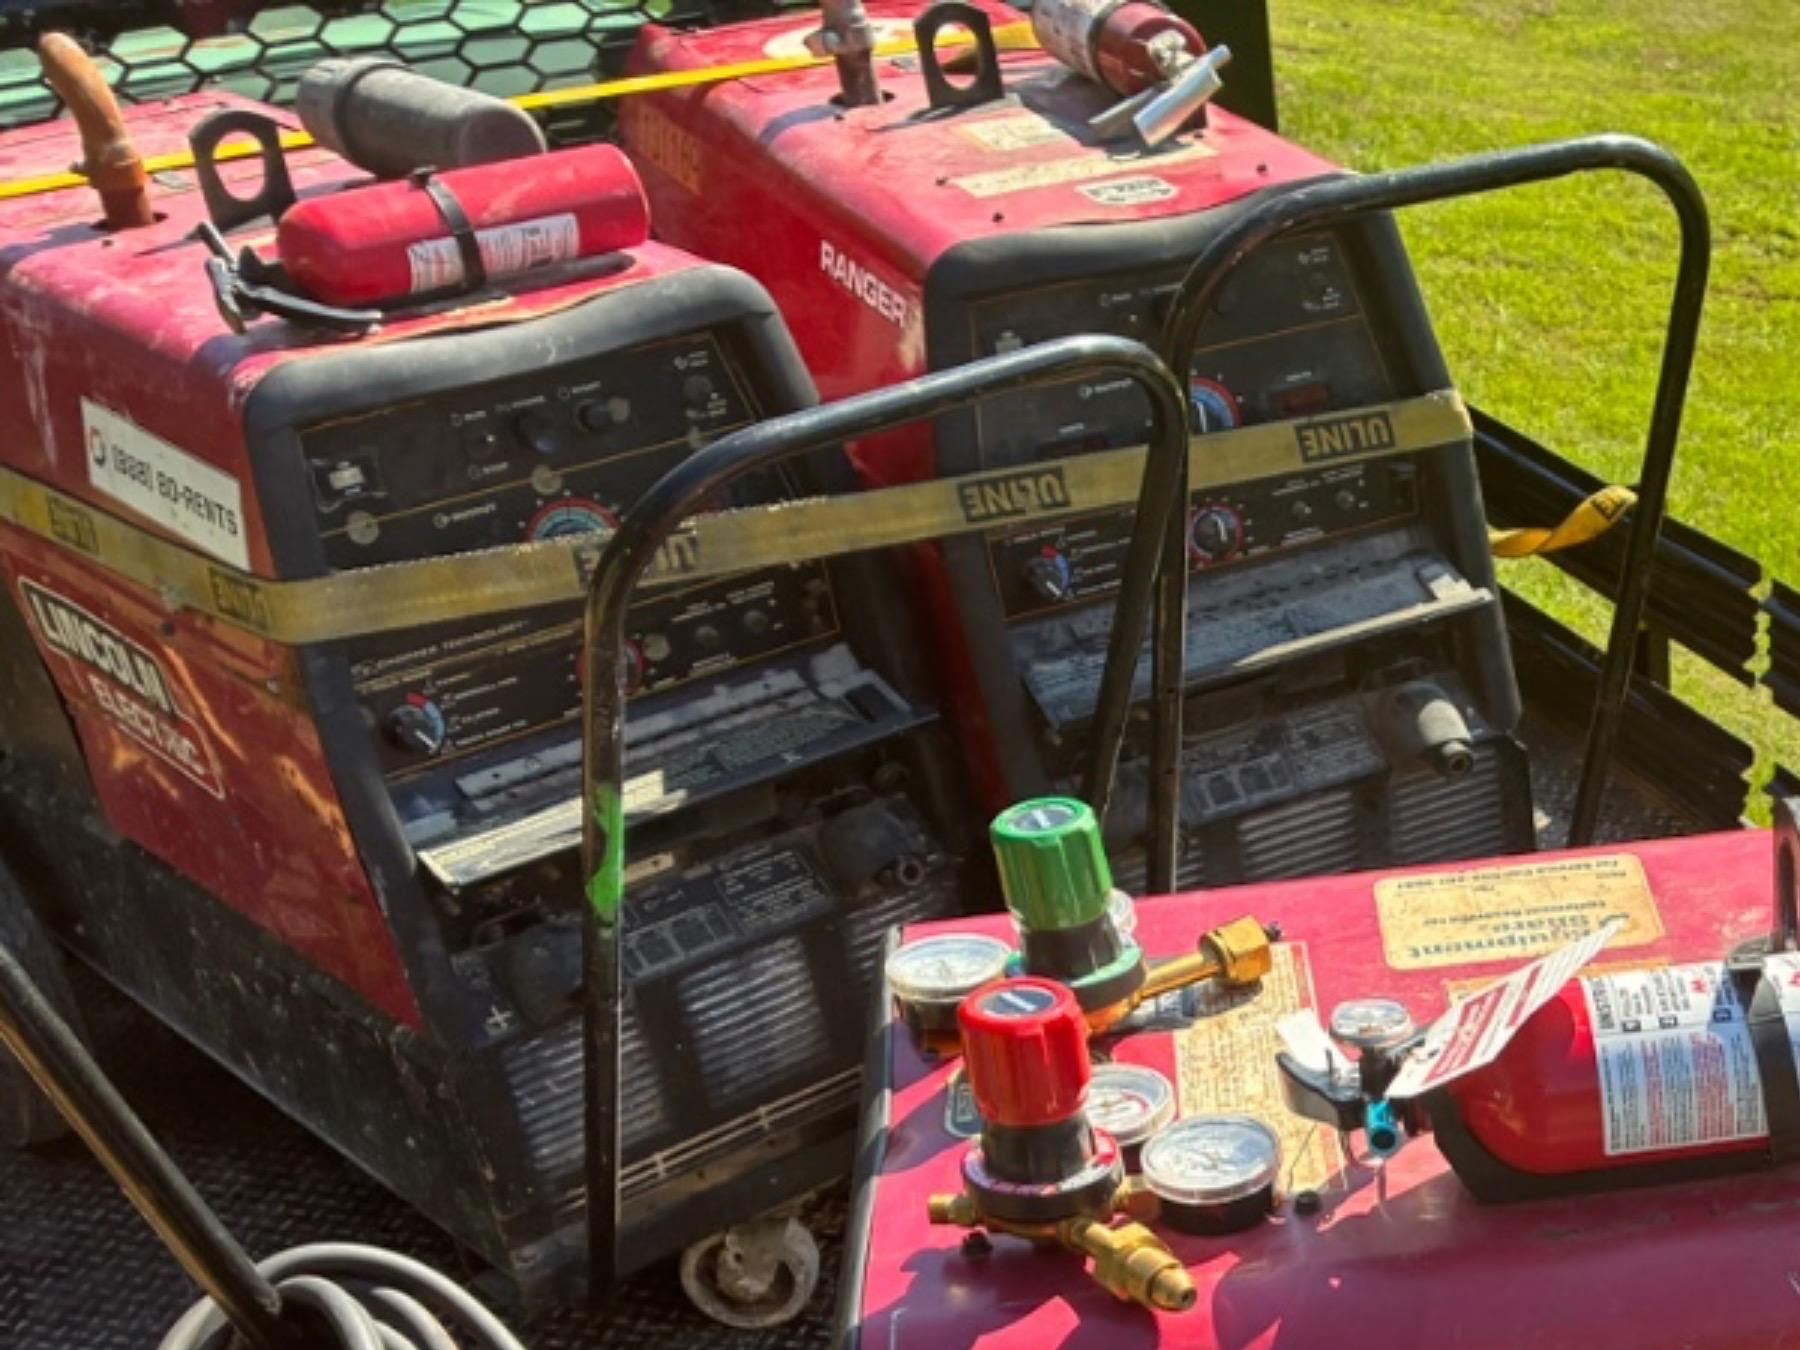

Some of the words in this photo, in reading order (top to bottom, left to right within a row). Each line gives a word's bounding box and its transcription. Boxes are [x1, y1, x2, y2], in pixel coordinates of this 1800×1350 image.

[819, 239, 907, 328] RANGER
[1301, 415, 1390, 457] ULINE
[963, 472, 1065, 520] ULINE
[31, 591, 173, 713] LINCOLN
